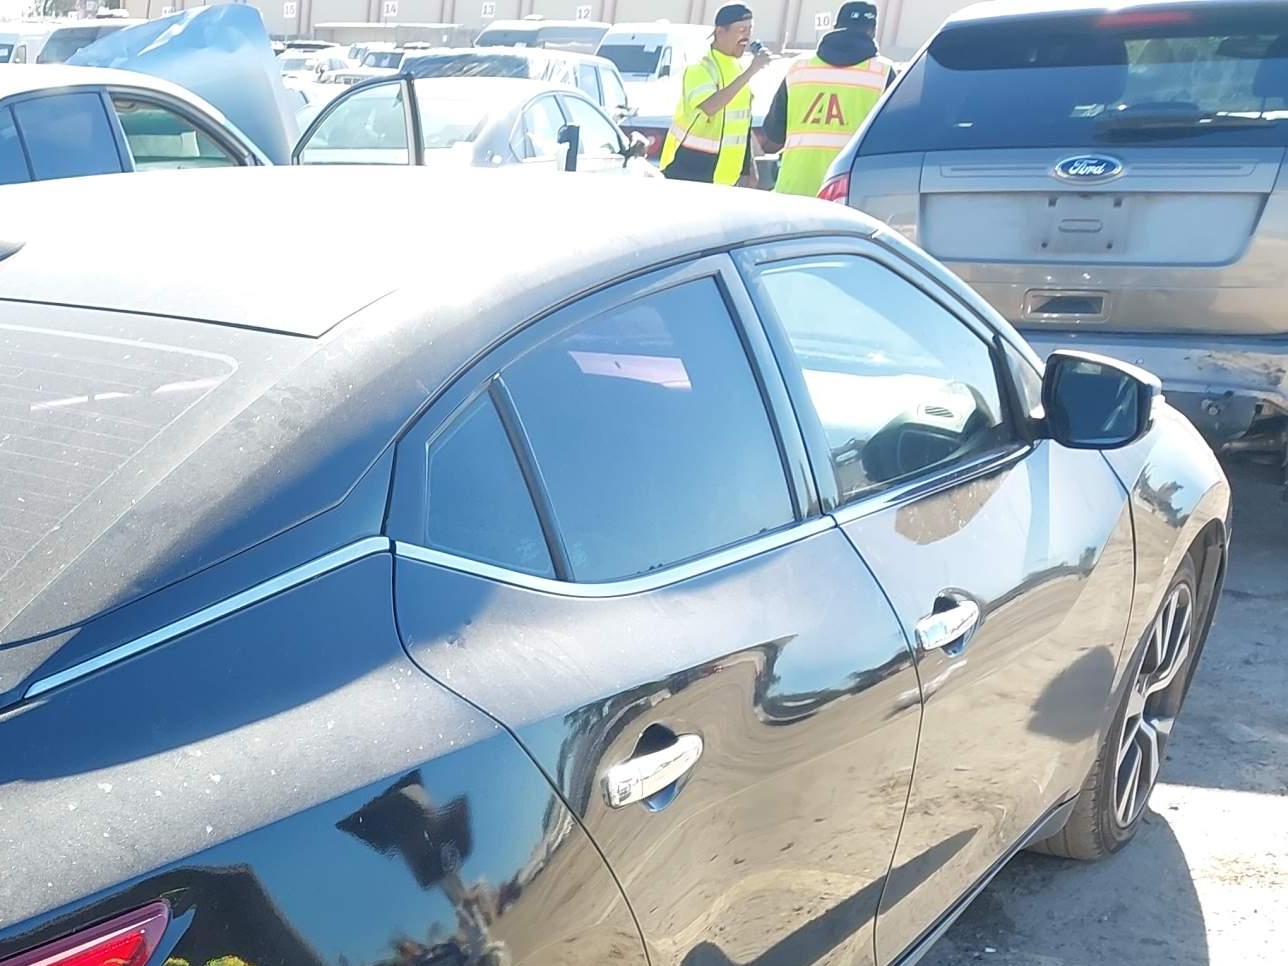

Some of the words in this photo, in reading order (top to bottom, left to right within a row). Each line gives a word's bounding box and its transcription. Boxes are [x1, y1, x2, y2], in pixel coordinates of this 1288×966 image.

[386, 3, 396, 14] 14
[578, 7, 590, 19] 12
[817, 16, 830, 27] 10
[1069, 159, 1106, 176] Ford
